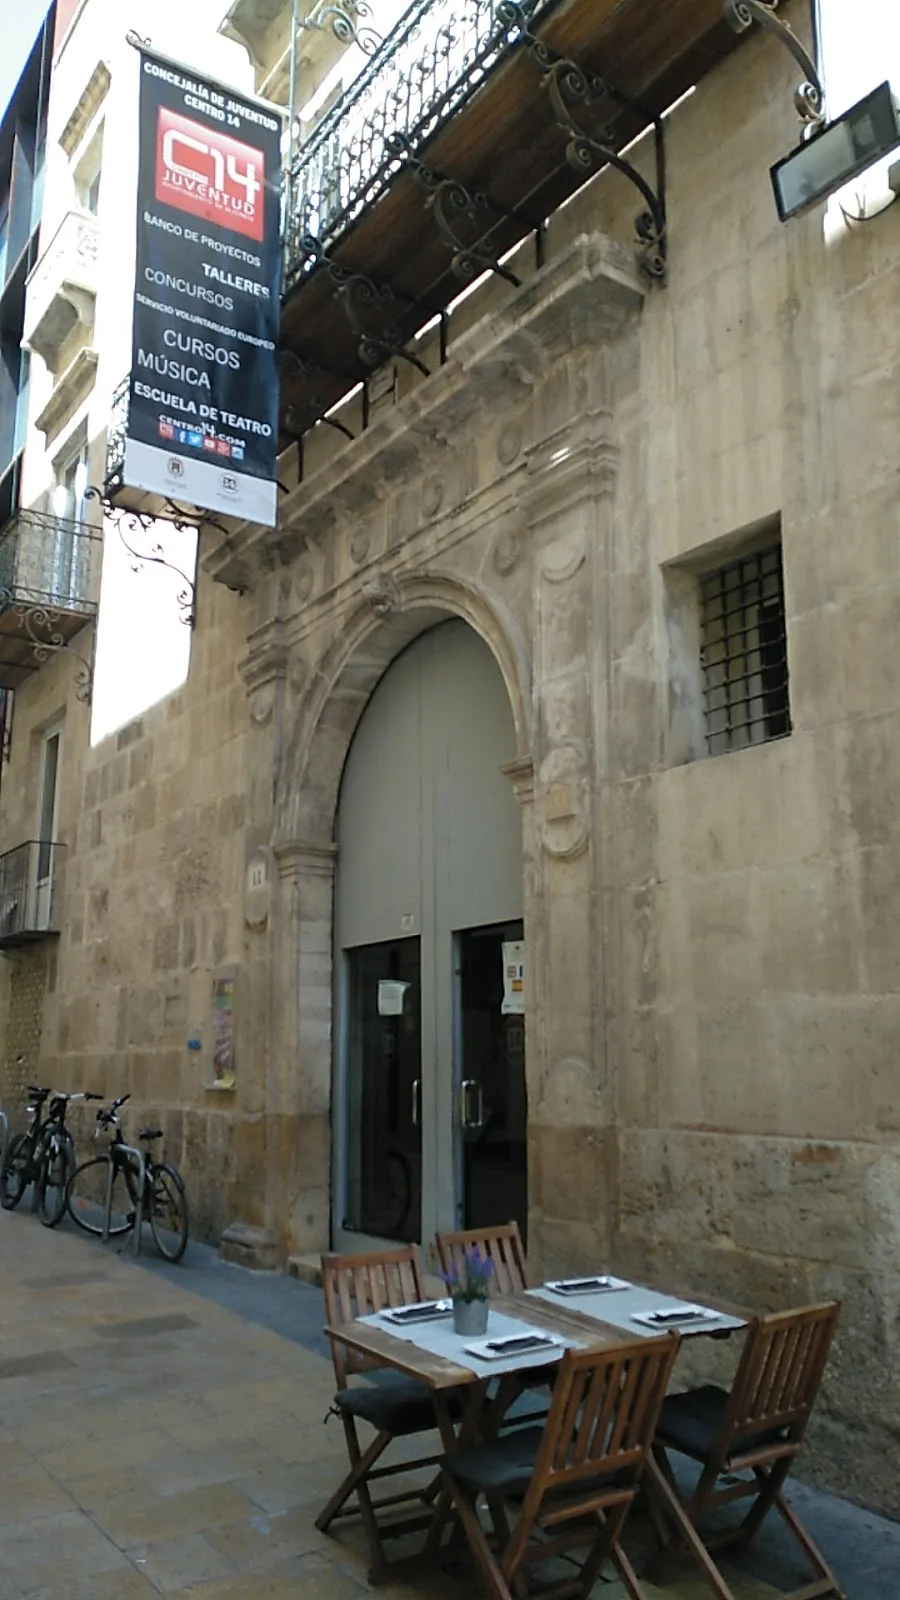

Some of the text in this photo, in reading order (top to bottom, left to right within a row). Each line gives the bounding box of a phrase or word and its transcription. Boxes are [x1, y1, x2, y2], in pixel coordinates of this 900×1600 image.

[143, 62, 279, 132] CONCEJALÍA DE JUVENTUD
[184, 94, 241, 128] CENTRO 14
[162, 169, 256, 216] JUVENTUD
[143, 211, 262, 267] BANCO DE PROYECTOS
[144, 267, 234, 311] CONCURSOS
[202, 263, 271, 299] TALLERES
[136, 293, 276, 350] SERVICIO VOLUNTARIADO EUROPEO
[137, 348, 212, 390] MÚSICA
[163, 329, 241, 370] CURSOS
[133, 381, 273, 437] ESCUELA DE TEATRO
